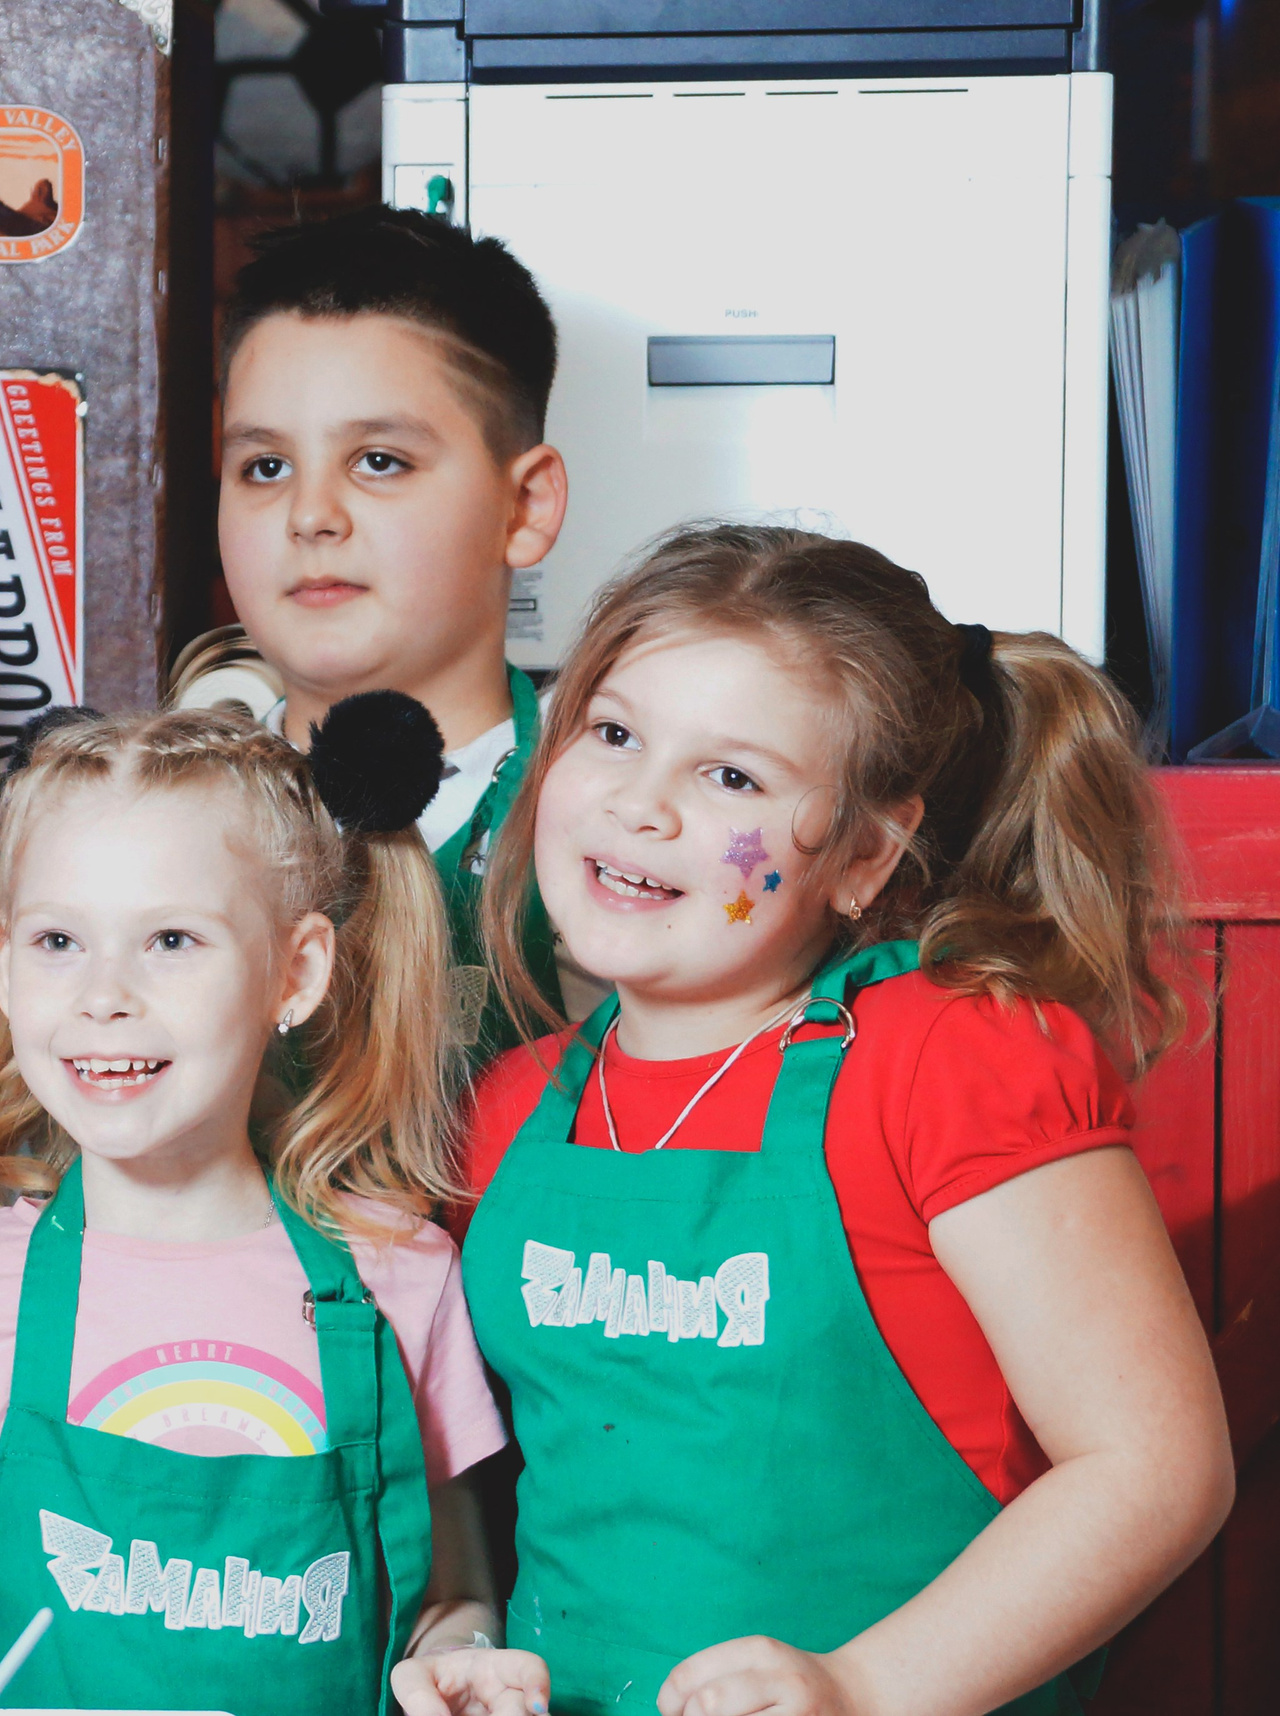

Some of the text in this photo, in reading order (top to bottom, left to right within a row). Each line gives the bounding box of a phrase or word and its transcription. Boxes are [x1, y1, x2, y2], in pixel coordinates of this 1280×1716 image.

[4, 110, 77, 151] VALLEY
[30, 220, 75, 256] PARK
[724, 308, 758, 319] PUSH
[6, 383, 74, 577] GREETINGS FROM
[156, 1342, 233, 1364] HEART
[162, 1407, 267, 1442] DREAMS
